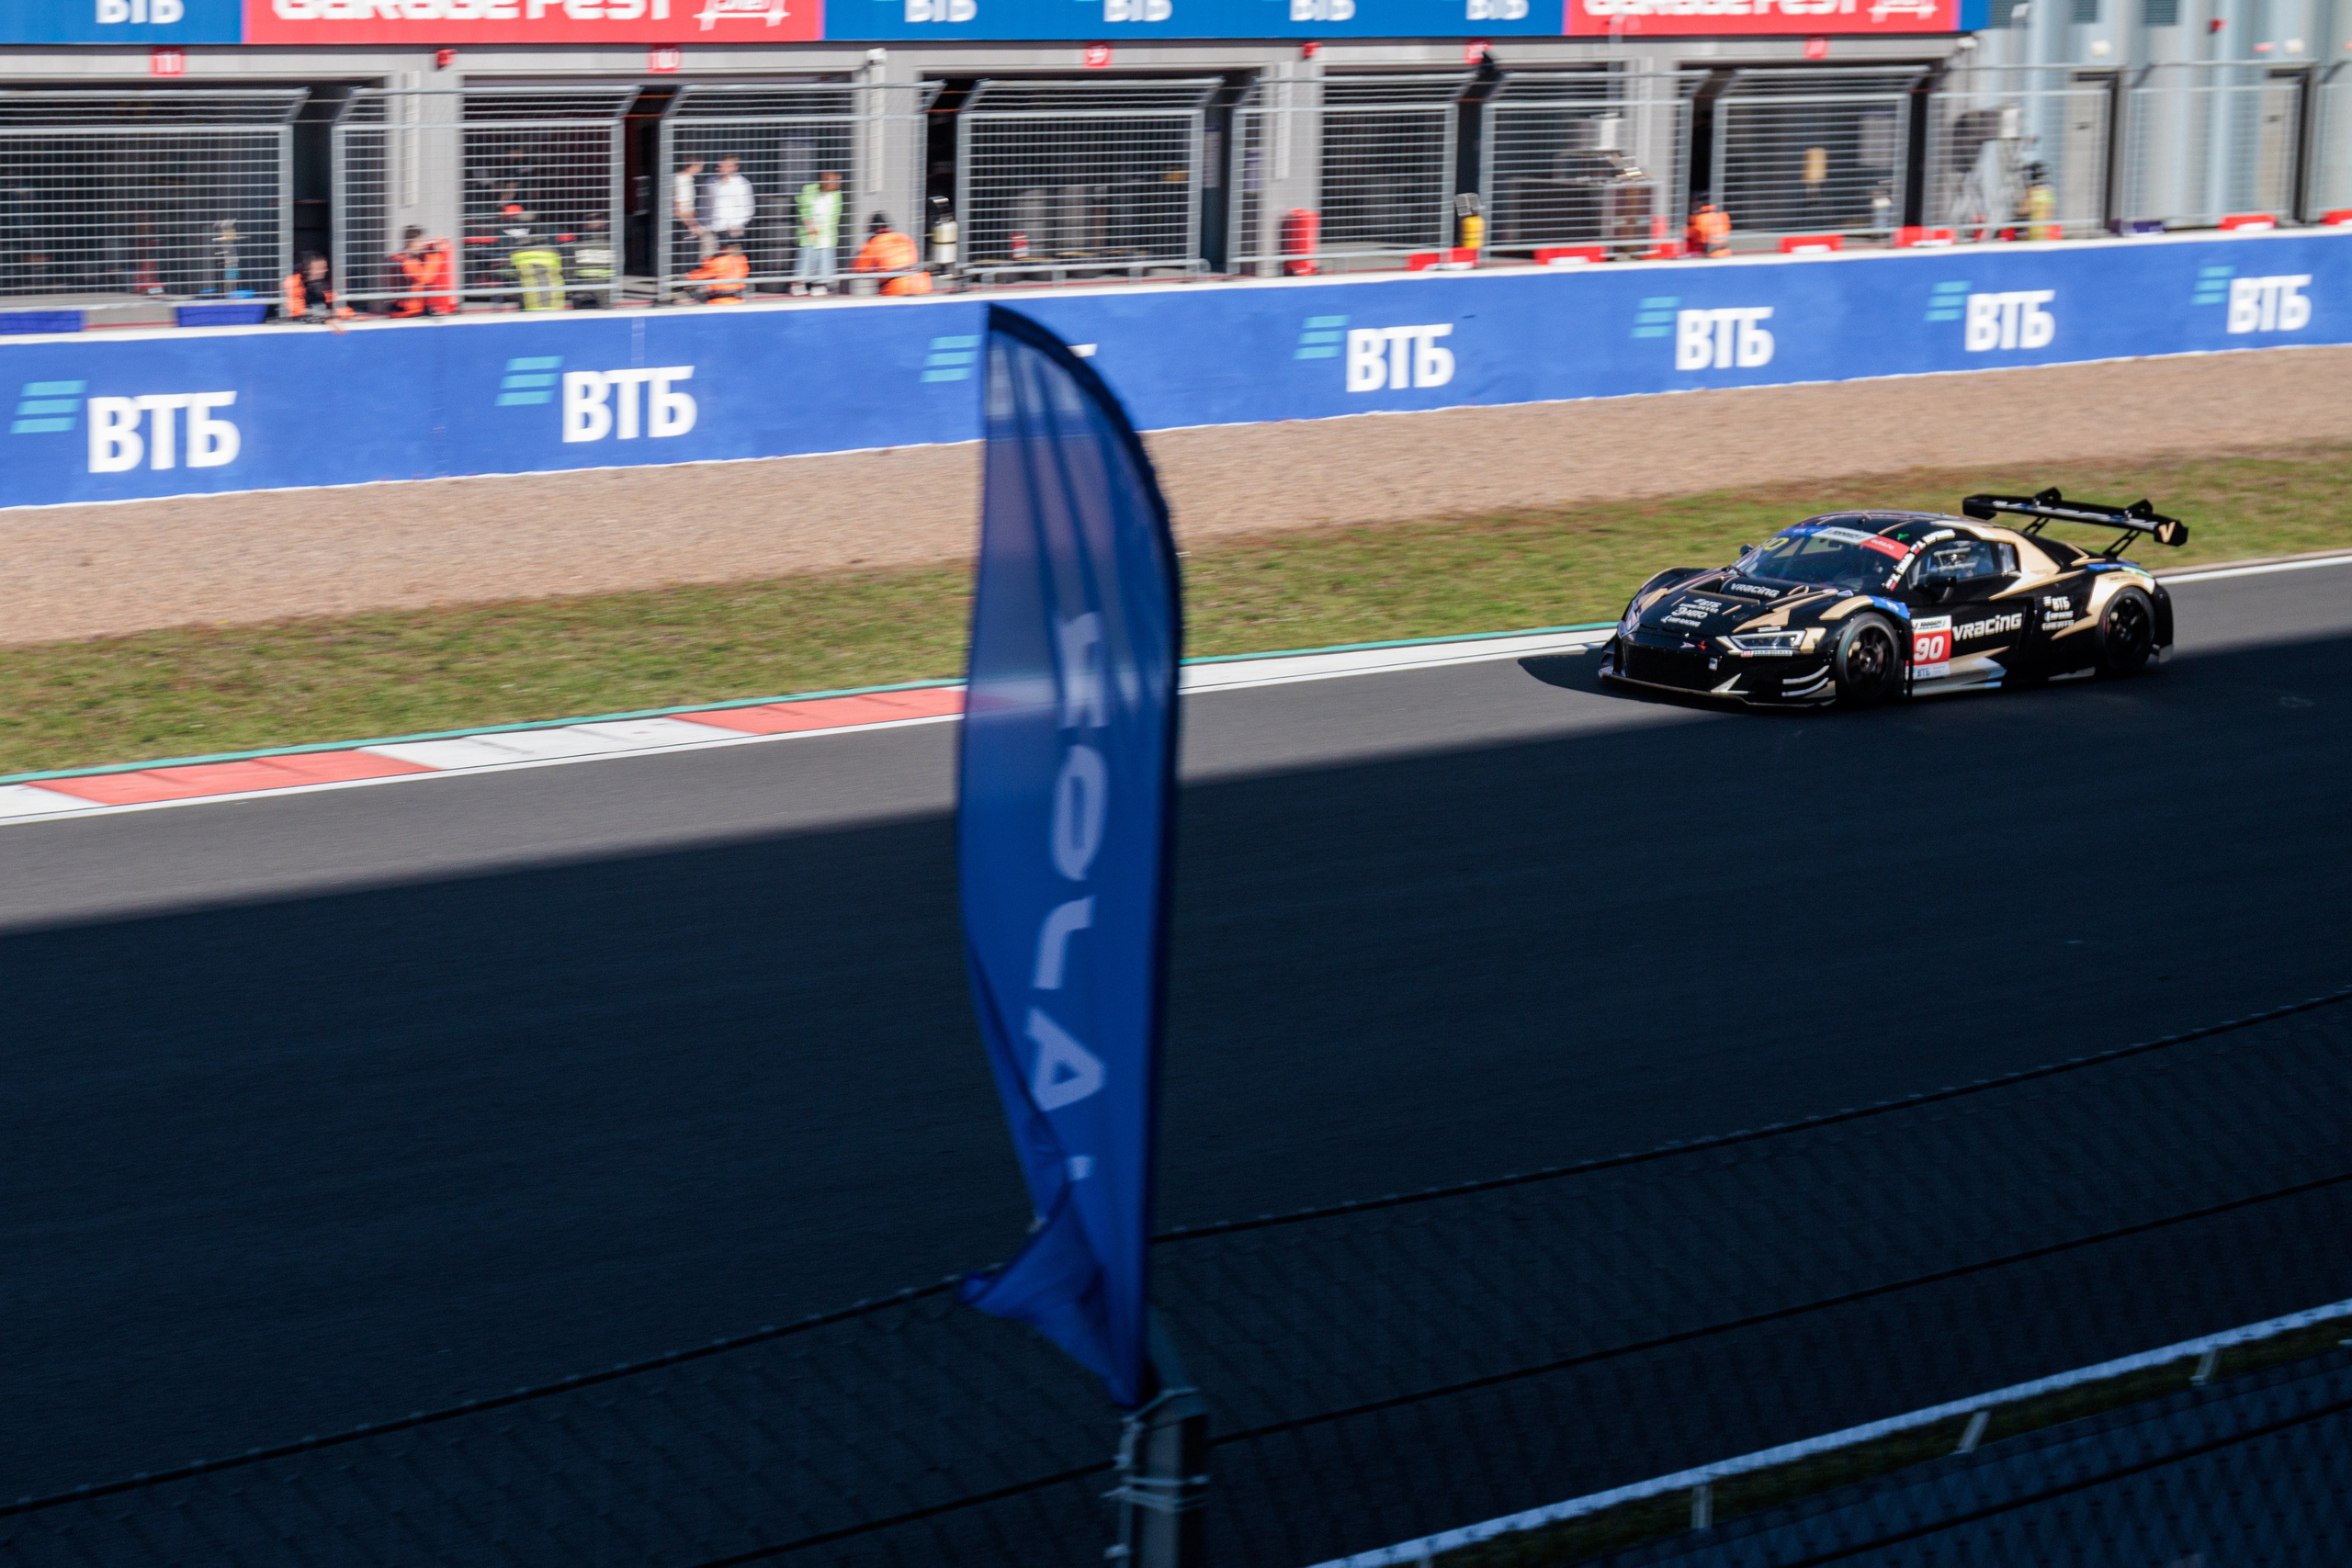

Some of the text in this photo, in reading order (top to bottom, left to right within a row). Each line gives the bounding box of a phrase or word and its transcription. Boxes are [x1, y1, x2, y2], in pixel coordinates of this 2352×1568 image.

[1964, 288, 2056, 353] ВТБ
[2226, 274, 2313, 335] ВТБ
[1345, 322, 1456, 393] ВТБ
[1675, 306, 1776, 371] ВТБ
[87, 390, 242, 474] ВТБ
[561, 365, 699, 444] ВТБ
[1914, 635, 1944, 661] 90
